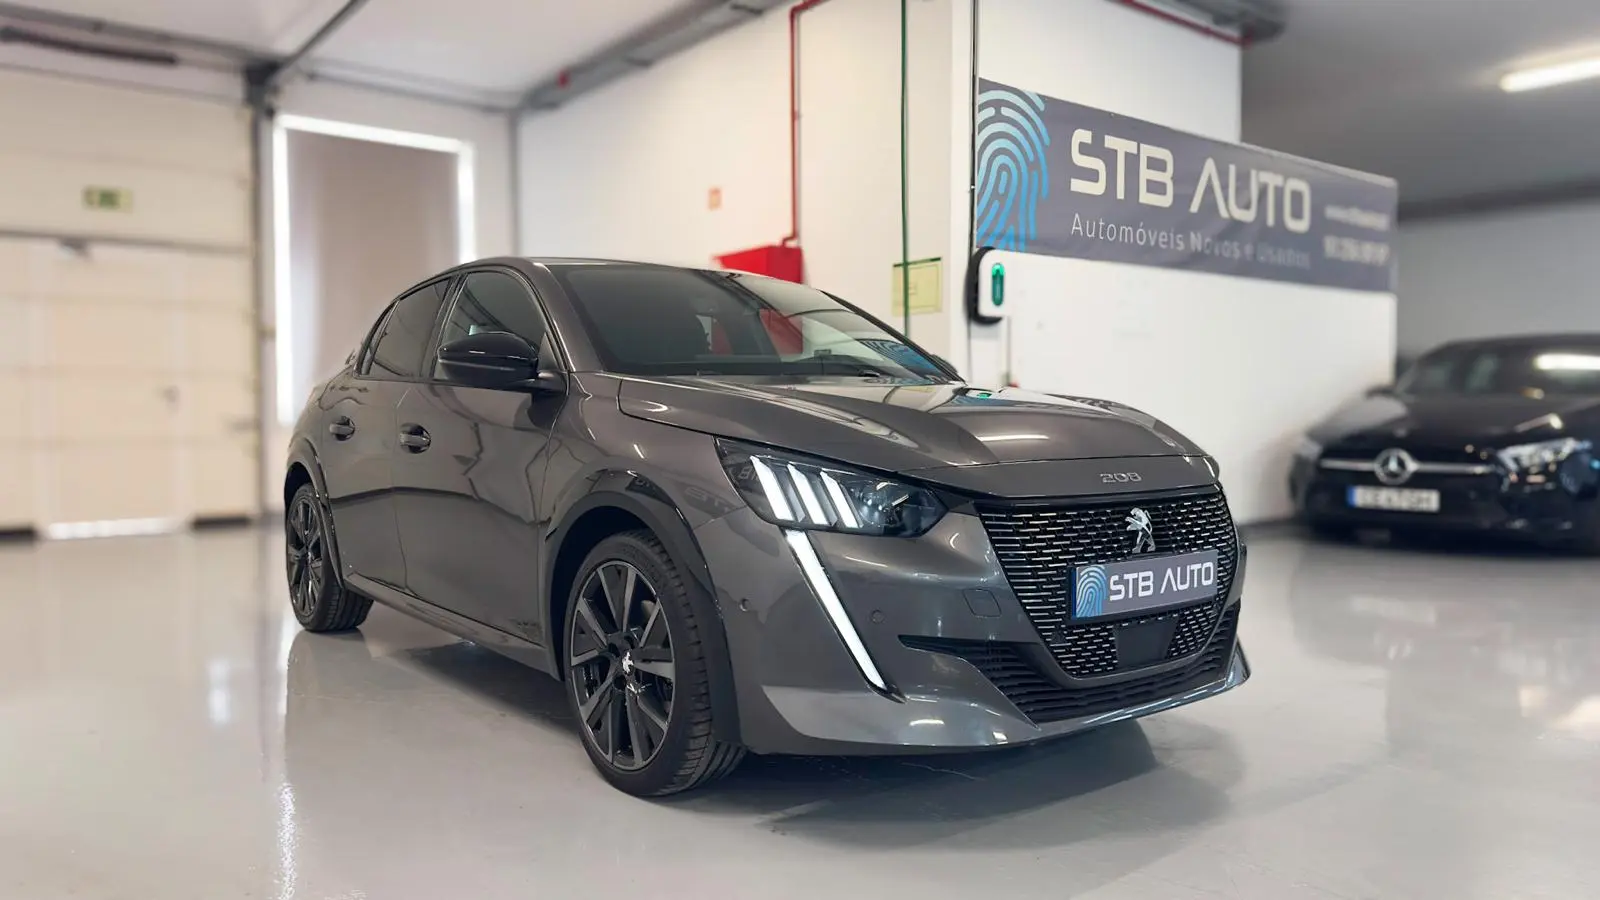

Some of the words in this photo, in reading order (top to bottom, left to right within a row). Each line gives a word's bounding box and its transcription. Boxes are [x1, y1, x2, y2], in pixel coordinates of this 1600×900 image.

[1070, 129, 1174, 208] STB
[1190, 157, 1311, 233] AUTO
[1071, 212, 1185, 251] Automóveis
[1100, 472, 1142, 483] 208
[1109, 570, 1154, 601] STB
[1160, 561, 1214, 594] AUTO
